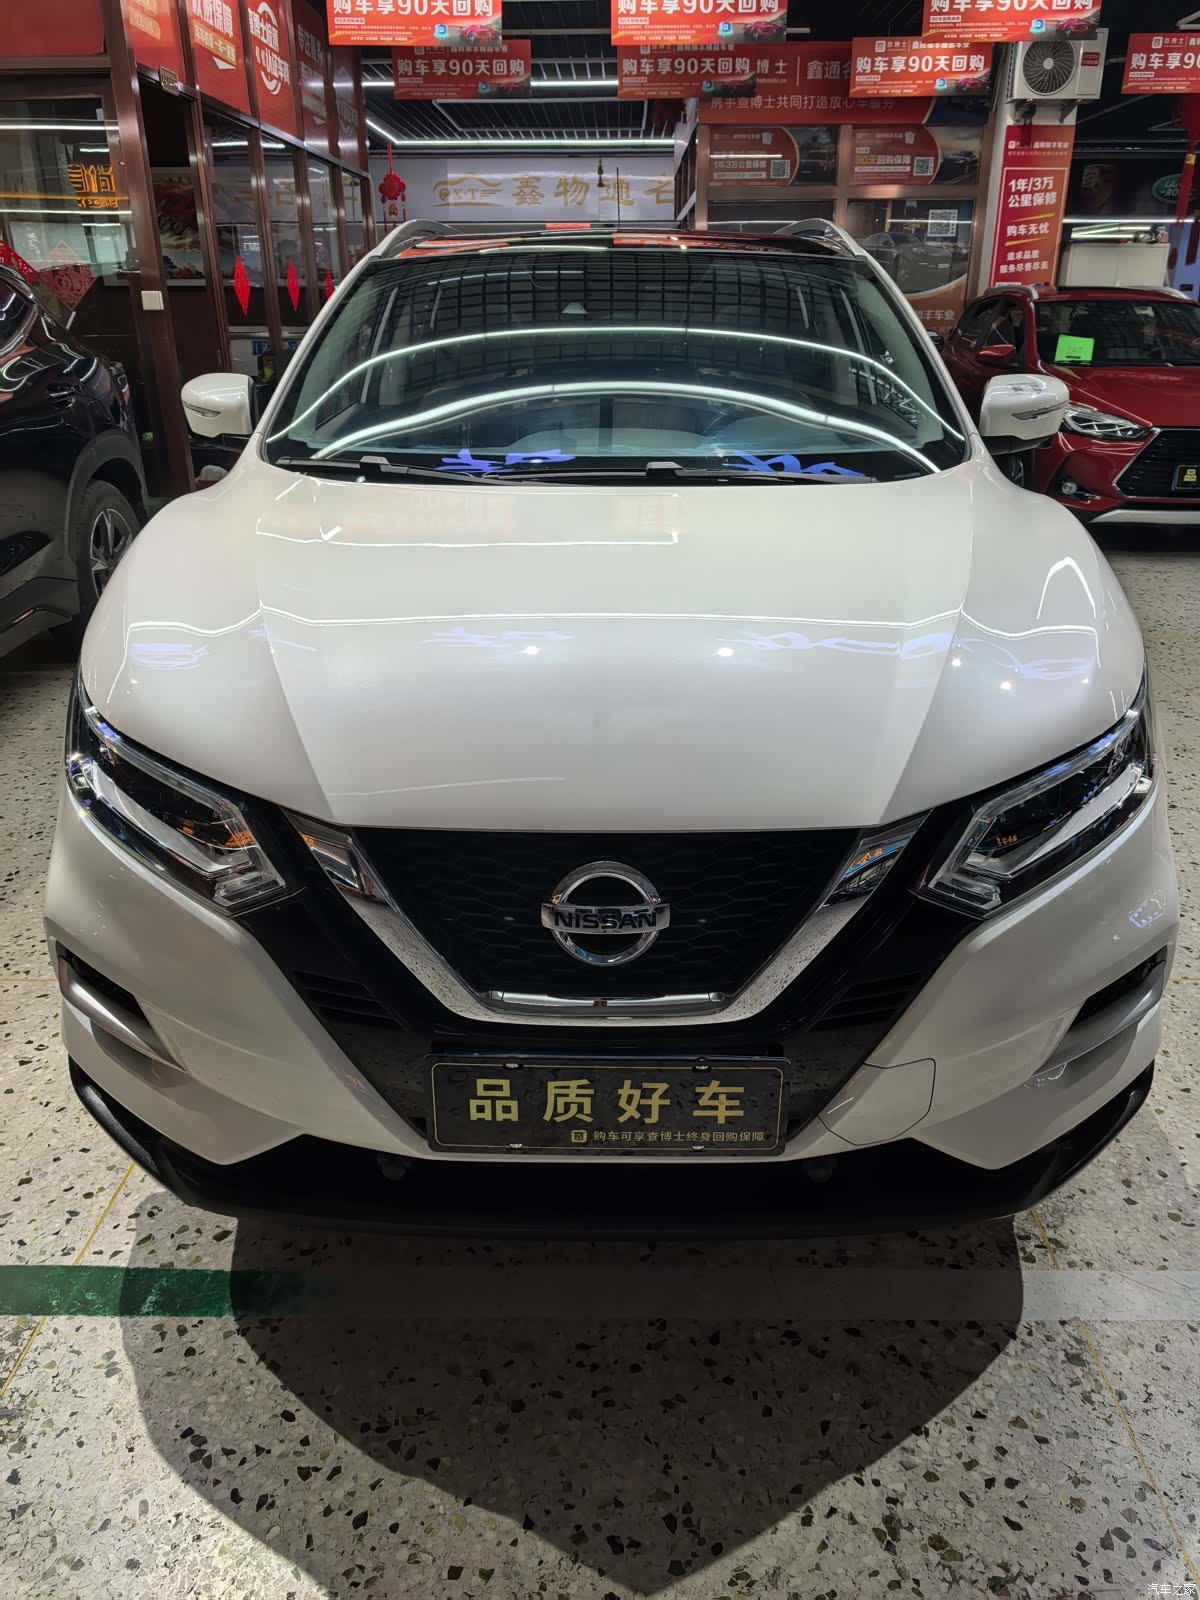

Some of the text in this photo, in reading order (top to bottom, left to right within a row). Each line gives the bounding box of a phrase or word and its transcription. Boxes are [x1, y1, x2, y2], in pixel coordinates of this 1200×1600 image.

[333, 0, 493, 17] 购车享90天回购
[397, 59, 525, 76] 购车享90天回购
[622, 58, 750, 75] 购车享90天回购
[856, 54, 985, 73] 购车享90天回购
[1008, 176, 1054, 193] 1年/3万
[1007, 191, 1057, 208] 公里保修
[1006, 222, 1050, 237] 购车无忧
[1184, 469, 1197, 482] 品
[554, 911, 657, 930] NISSAN
[469, 1078, 745, 1124] 品质好车
[593, 1130, 765, 1143] 购车可享查博士终身回购保障
